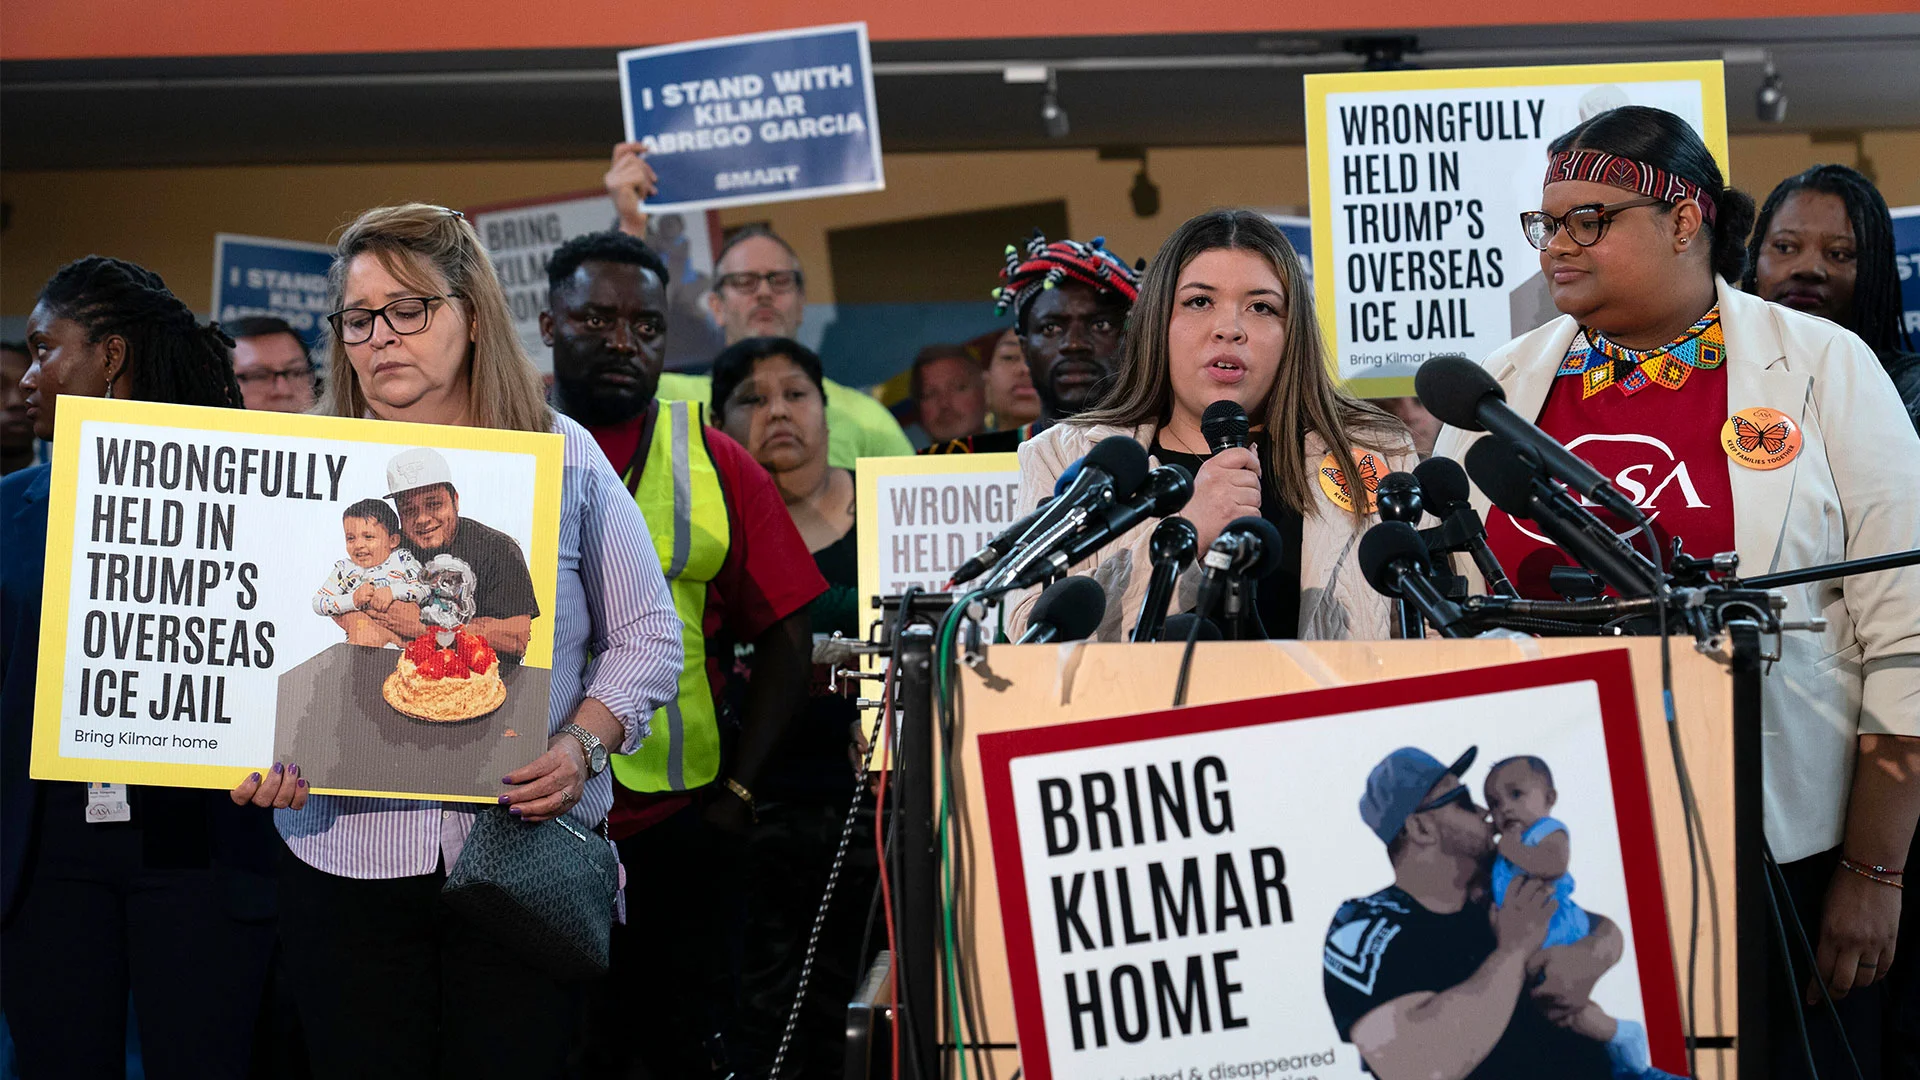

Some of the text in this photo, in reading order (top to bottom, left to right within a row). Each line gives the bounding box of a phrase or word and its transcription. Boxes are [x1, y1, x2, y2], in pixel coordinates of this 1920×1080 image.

[642, 64, 853, 110] I STAND WITH
[693, 94, 806, 126] KILMAR
[1340, 99, 1545, 145] WRONGFULLY
[641, 112, 867, 157] ABREGO GARCIA
[715, 165, 800, 191] SMART
[1343, 151, 1460, 195] HELD IN
[486, 212, 562, 252] BRING
[1343, 199, 1485, 244] TRUMP'S
[229, 266, 241, 288] I
[1348, 247, 1504, 293] OVERSEAS
[1350, 298, 1475, 342] ICE JAIL
[1350, 354, 1382, 368] Bring
[1386, 352, 1426, 364] Kilmar
[96, 436, 348, 502] WRONGFULLY
[1727, 440, 1795, 465] KEEP FAMILIES TOGETHER
[890, 484, 1018, 526] WRONGF
[1334, 492, 1349, 504] KEEP
[91, 494, 235, 551] HELD IN
[892, 533, 965, 574] HELD
[87, 552, 259, 610] TRUMP'S
[83, 610, 275, 669] OVERSEAS
[79, 668, 232, 724] ICE JAIL
[74, 729, 218, 749] Bring Kilmar home
[1038, 756, 1234, 857] BRING
[1050, 846, 1294, 953] KILMAR
[1064, 950, 1249, 1051] HOME
[1208, 1047, 1335, 1080] disappeared
